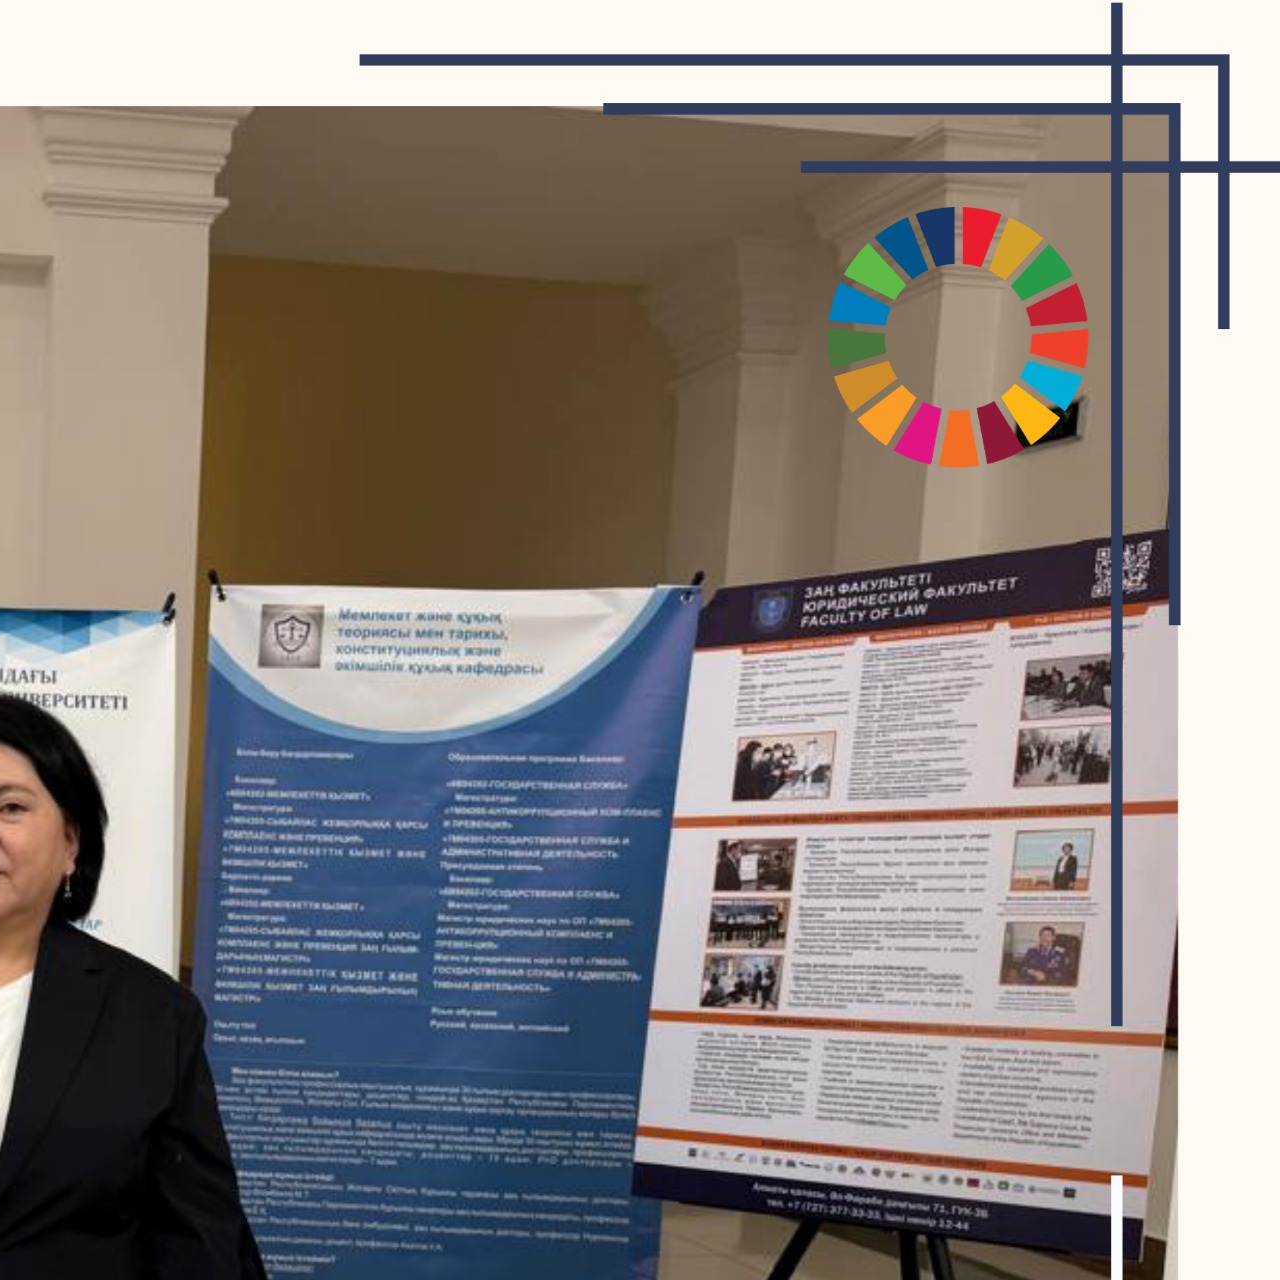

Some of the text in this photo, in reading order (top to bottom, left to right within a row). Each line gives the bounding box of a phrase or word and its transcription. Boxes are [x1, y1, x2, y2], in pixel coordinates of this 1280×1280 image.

[838, 572, 932, 593] ФАКУЛЬТЕТІ
[802, 577, 1018, 613] ЮРИДИЧЕСКИЙ ФАКУЛЬТЕТ
[338, 608, 410, 621] Мемлекет
[801, 604, 928, 628] FACULTY OF LAW
[338, 628, 411, 640] теориясы
[415, 629, 443, 638] мен
